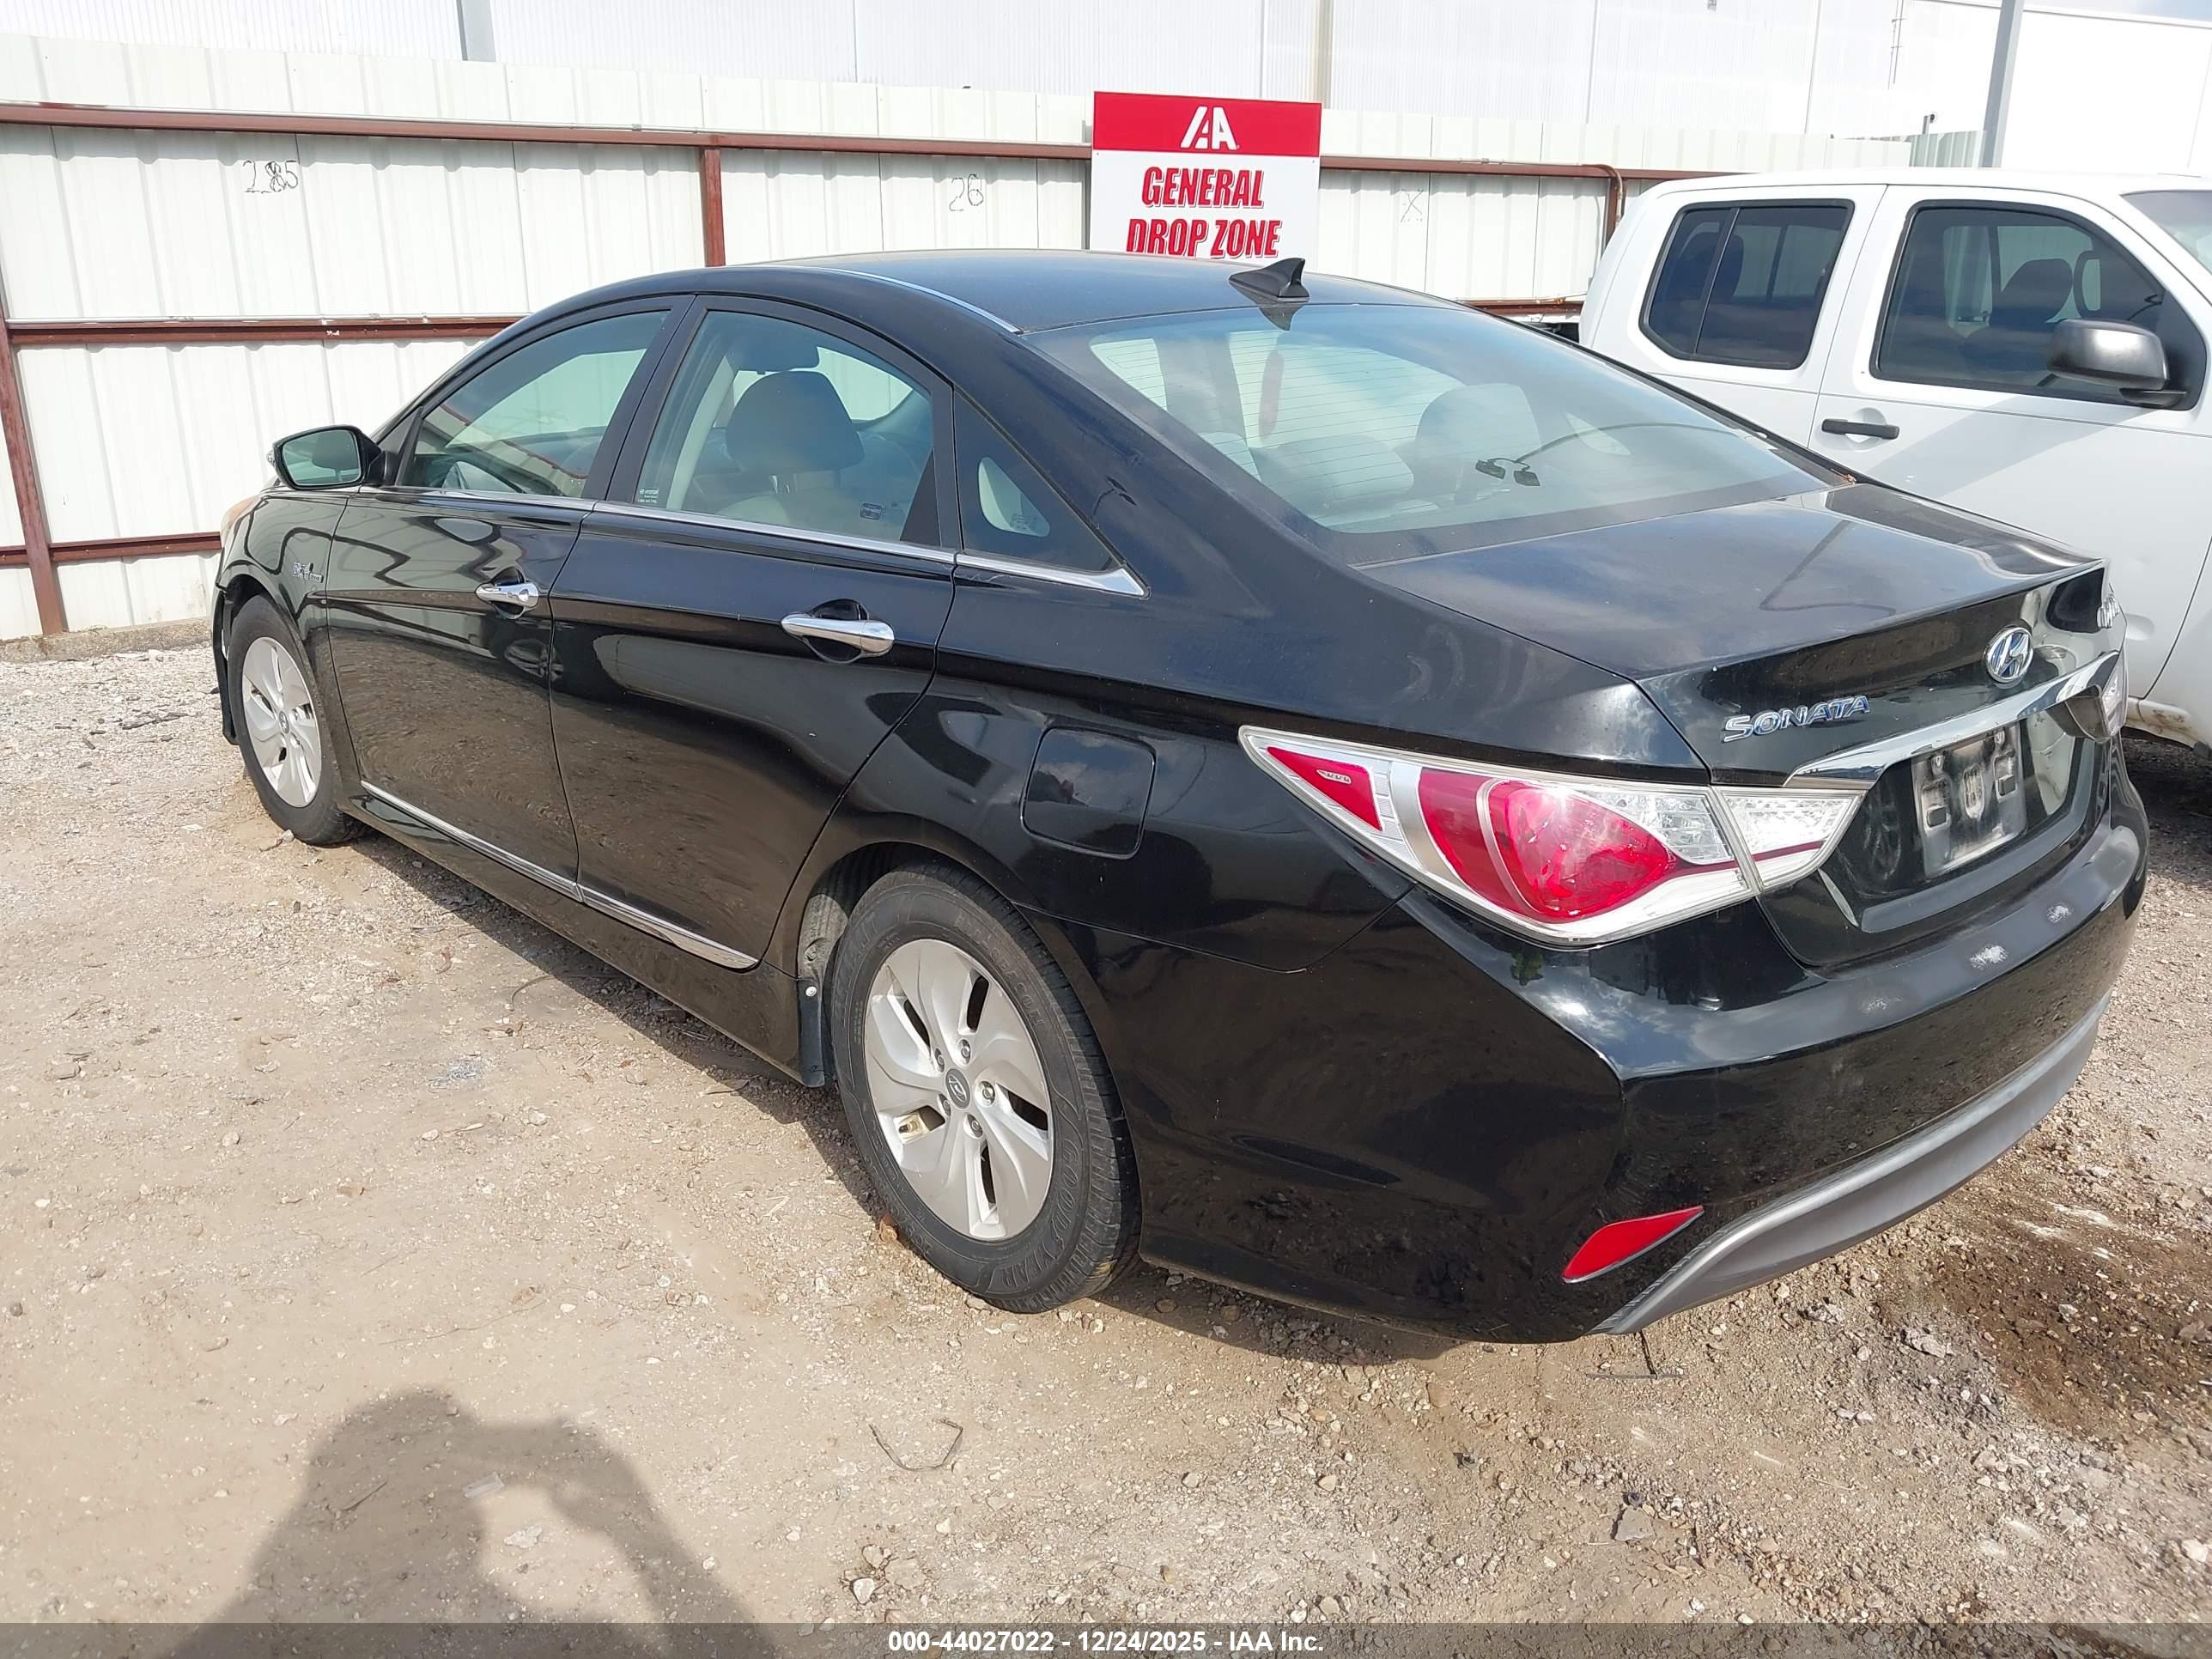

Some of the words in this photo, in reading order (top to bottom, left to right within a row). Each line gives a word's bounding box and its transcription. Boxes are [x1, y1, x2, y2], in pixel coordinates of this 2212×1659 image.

[1141, 167, 1264, 208] GENERAL
[1126, 218, 1208, 257] DROP
[1210, 219, 1282, 258] ZONE
[1723, 695, 1871, 744] SONATA
